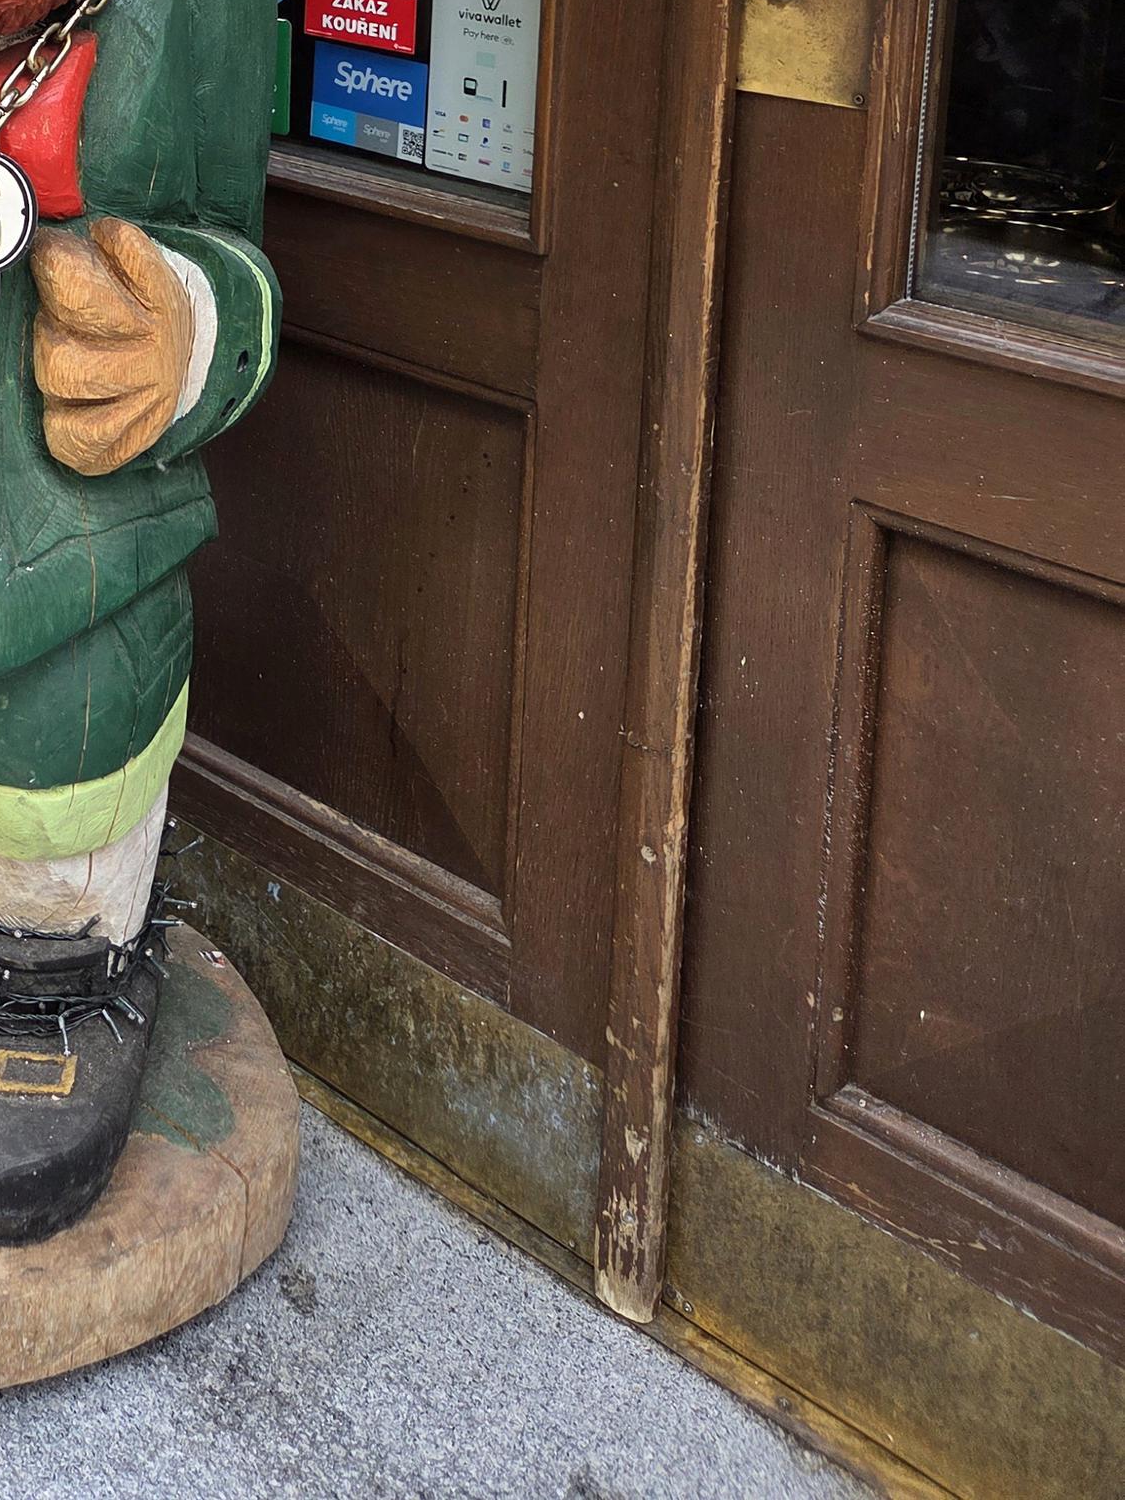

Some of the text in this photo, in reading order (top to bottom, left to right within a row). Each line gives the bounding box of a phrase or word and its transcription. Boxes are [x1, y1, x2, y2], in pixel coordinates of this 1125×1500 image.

[321, 14, 399, 41] KOUŘENÍ
[463, 28, 500, 43] Pay here
[334, 61, 413, 101] Sphere
[321, 113, 348, 128] Sphere
[363, 124, 391, 141] Sphere
